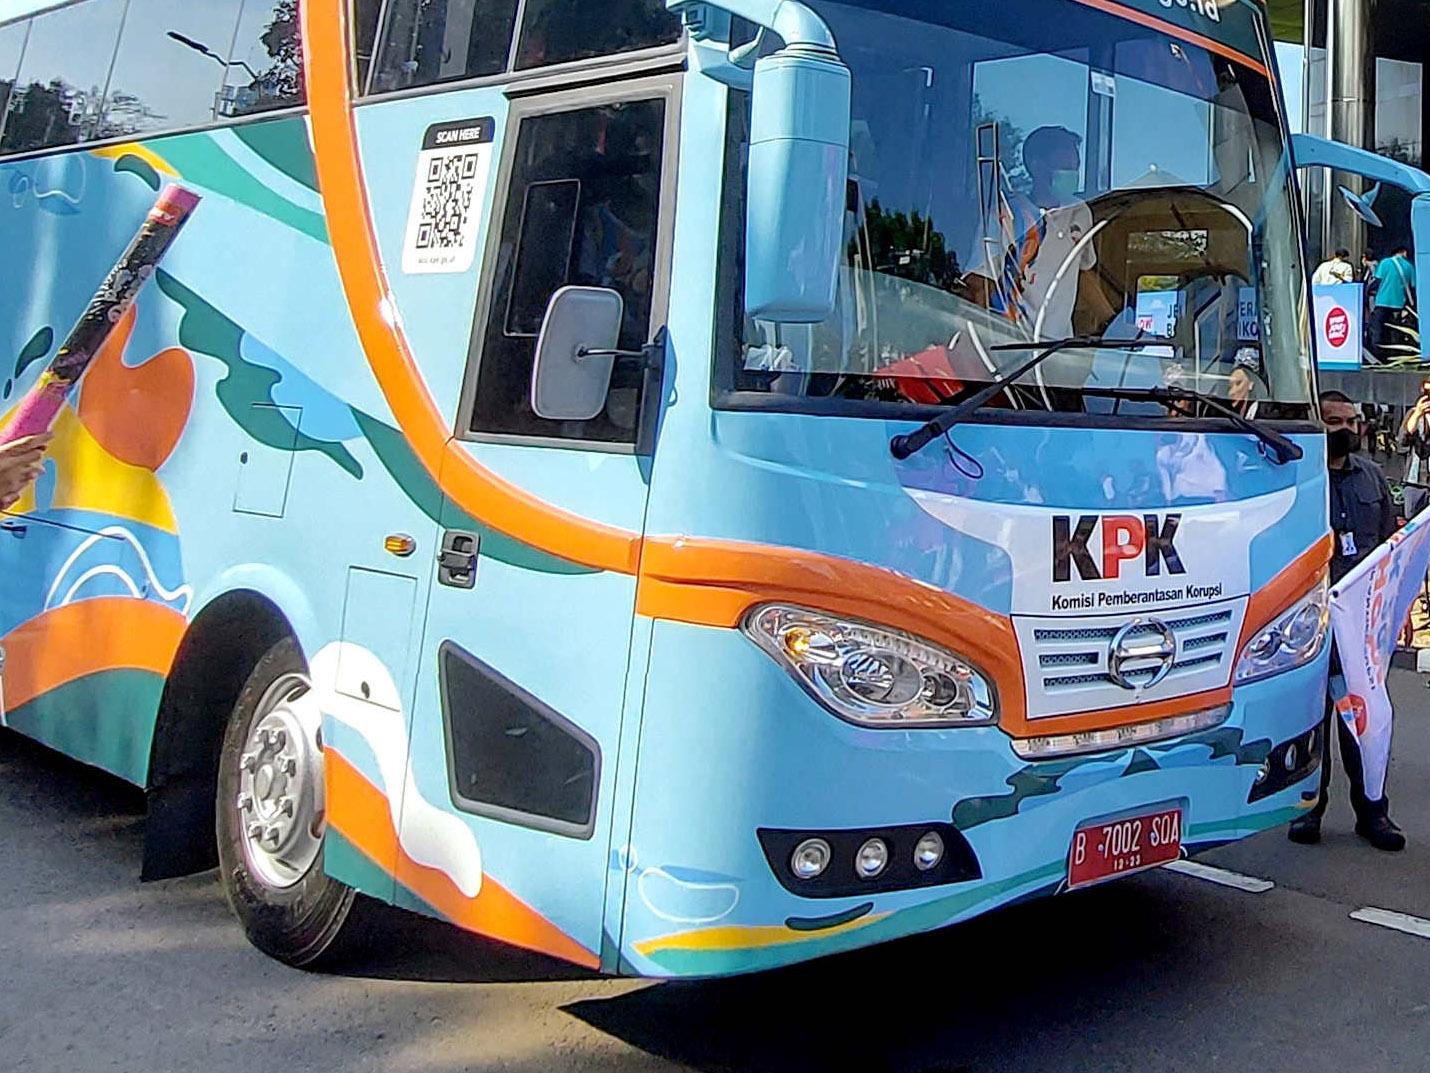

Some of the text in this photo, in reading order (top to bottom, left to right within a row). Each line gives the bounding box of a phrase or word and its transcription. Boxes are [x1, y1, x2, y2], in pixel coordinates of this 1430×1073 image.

[435, 129, 459, 144] SCAN
[1052, 513, 1187, 583] KPK
[1052, 582, 1222, 610] Komisi Pemberantasan Korupsi
[1075, 832, 1087, 865] B
[1102, 820, 1142, 859] 7002
